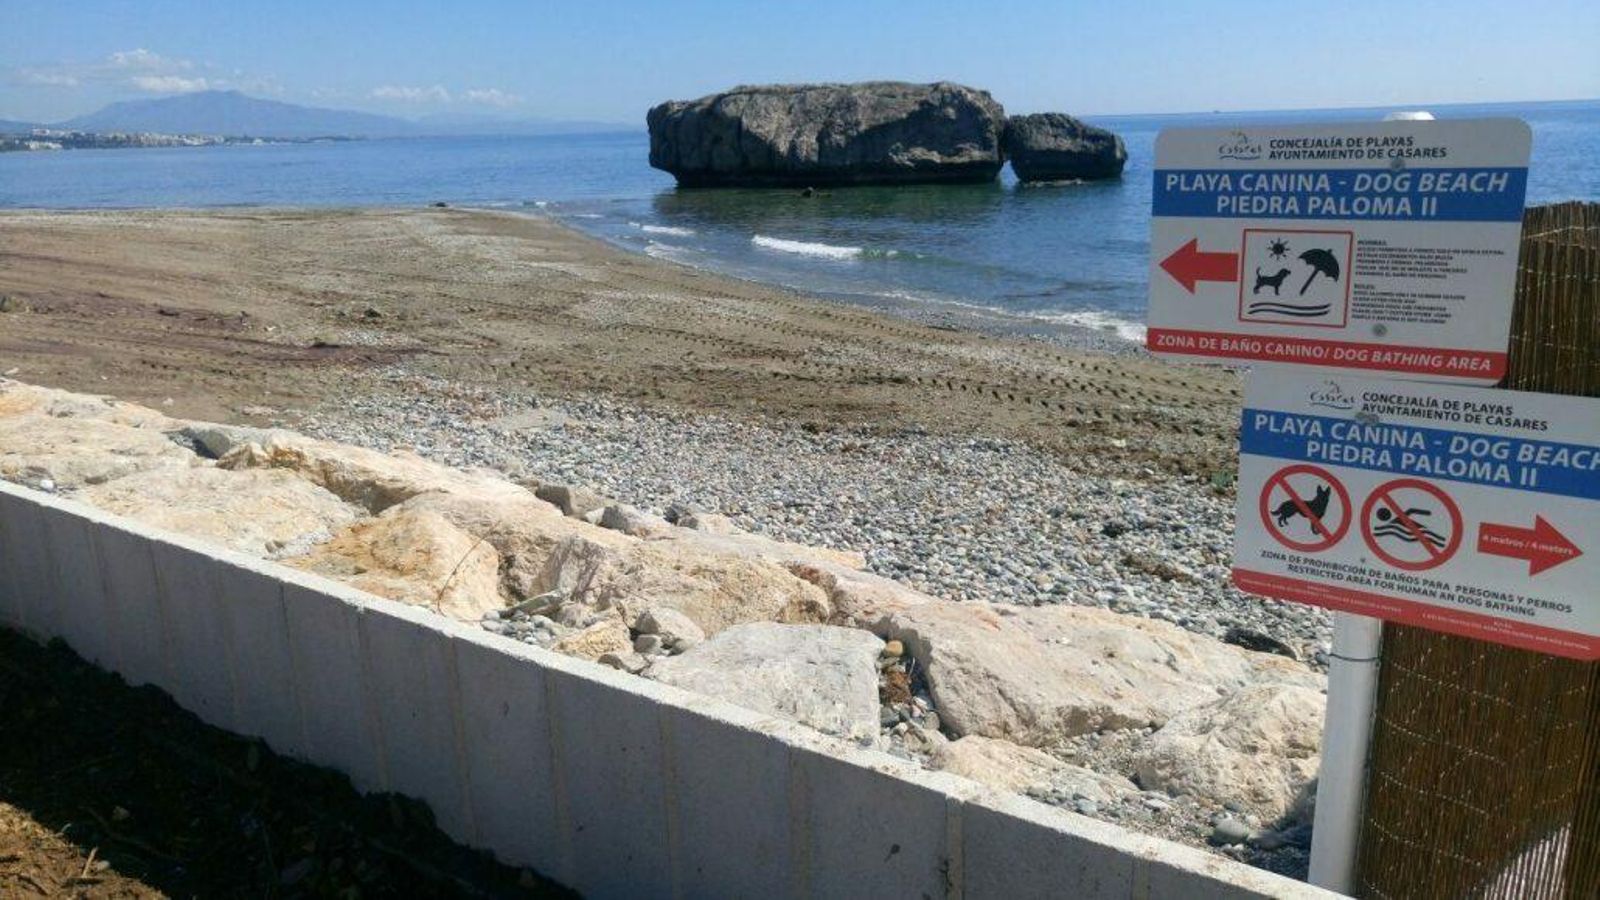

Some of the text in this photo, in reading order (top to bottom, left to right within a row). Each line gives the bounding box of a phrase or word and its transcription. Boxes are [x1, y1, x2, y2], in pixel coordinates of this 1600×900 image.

[1269, 136, 1414, 149] CONCEJALÍA DE PLAYAS
[1269, 147, 1447, 160] AYUNTAMIENTO DE CASARES
[1166, 174, 1233, 192] PLAYA
[1238, 174, 1331, 193] CANINA
[1353, 172, 1411, 193] DOG
[1417, 172, 1509, 193] BEACH
[1216, 195, 1437, 216] PIEDRA PALOMA II
[1156, 333, 1492, 372] ZONA DE BAÑO CANINO/ DOG BATHING AREA
[1362, 392, 1513, 416] CONCEJALÍA DE PLAYAS
[1362, 403, 1548, 432] AYUNTAMIENTO DE CASARES
[1254, 414, 1323, 438] PLAYA
[1330, 421, 1426, 450] CANINA
[1450, 436, 1509, 460] DOG
[1306, 440, 1538, 487] PIEDRA PALOMA II
[1260, 550, 1287, 561] ZONA
[1288, 555, 1302, 564] DE
[1368, 568, 1382, 579] DE
[1384, 570, 1420, 585] BAÑOS
[1422, 579, 1450, 591] PARA
[1455, 585, 1514, 603] PERSONAS
[1516, 596, 1525, 604] Y
[1527, 598, 1573, 614] PERROS
[1287, 564, 1536, 617] RESTRICTED AREA FOR HUMAN AN DOG BATHING
